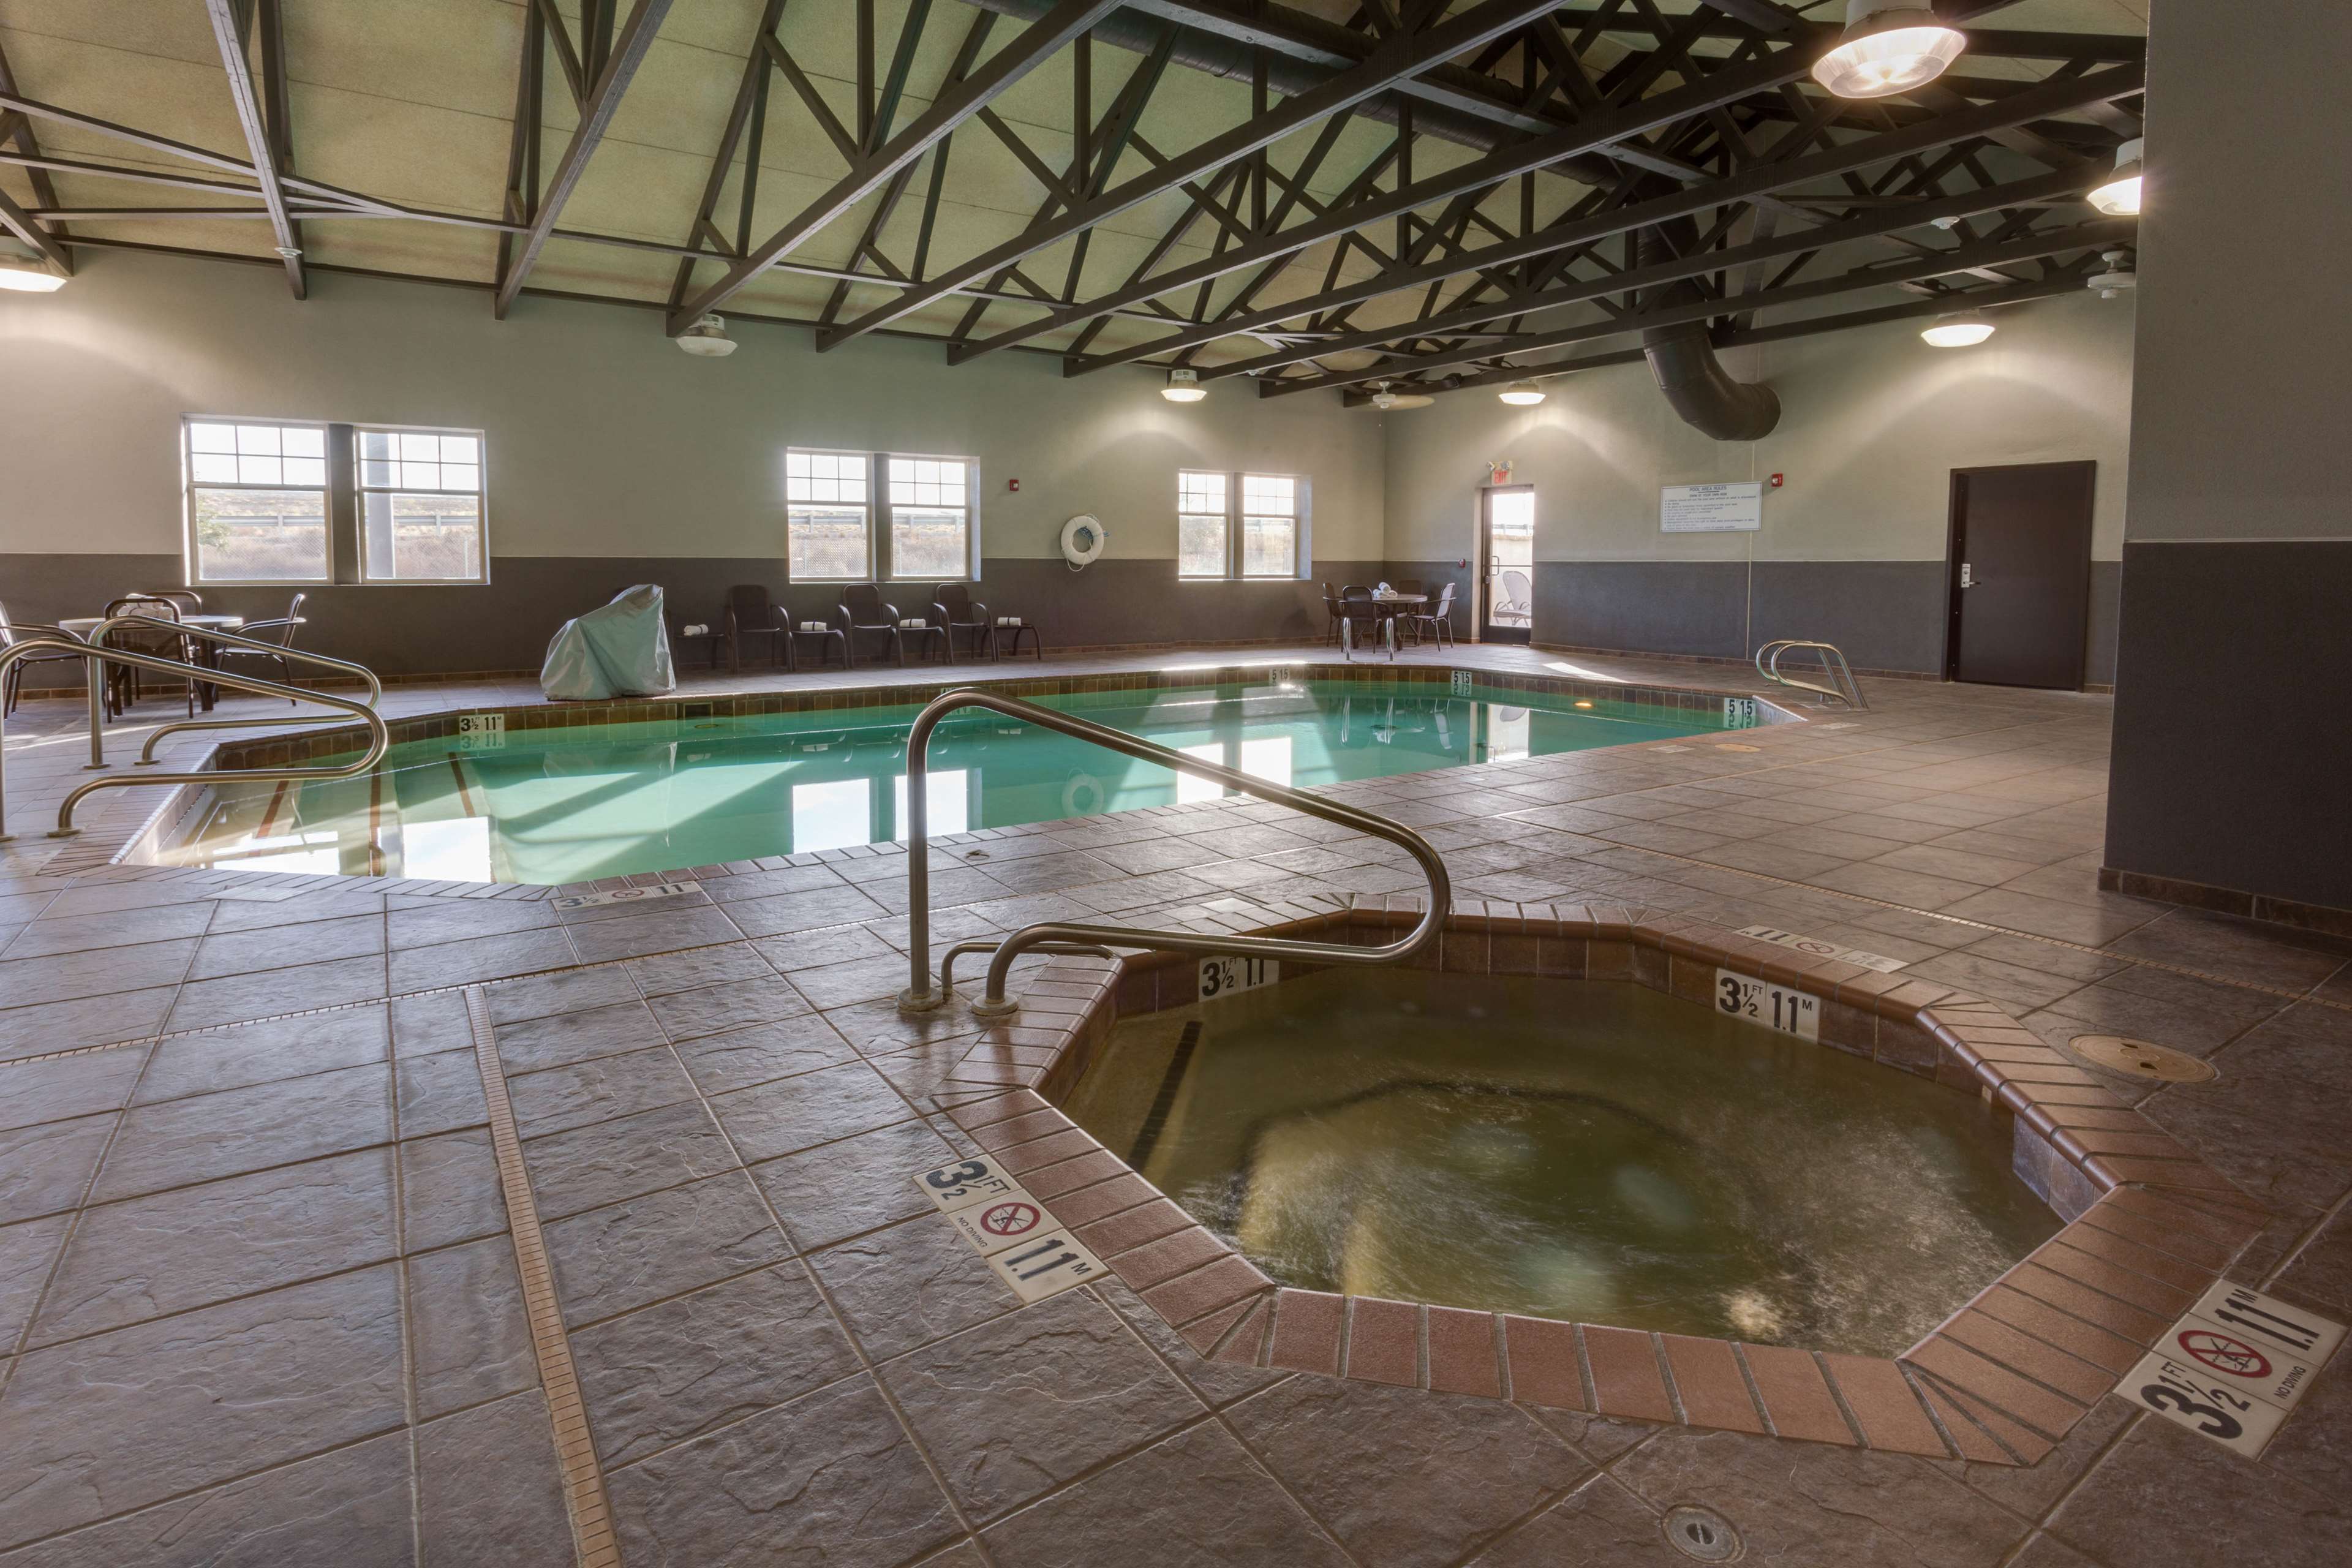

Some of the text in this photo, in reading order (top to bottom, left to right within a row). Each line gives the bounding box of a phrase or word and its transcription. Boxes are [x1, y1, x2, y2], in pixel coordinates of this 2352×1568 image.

[1494, 470, 1508, 484] EXIT
[1272, 669, 1276, 680] 5
[1454, 671, 1458, 683] 5
[1729, 699, 1752, 715] 5 1.5
[1229, 957, 1237, 965] FT
[1752, 984, 1763, 995] FT
[1771, 990, 1798, 1034] 1.1
[1802, 998, 1812, 1011] M
[983, 1178, 1011, 1194] FT
[958, 1216, 988, 1248] NO DIVING
[1004, 1238, 1092, 1281] 1.1 M
[2214, 1288, 2320, 1351] 1.1 M
[2160, 1361, 2187, 1378] FT
[2274, 1366, 2307, 1400] NO DIVING
